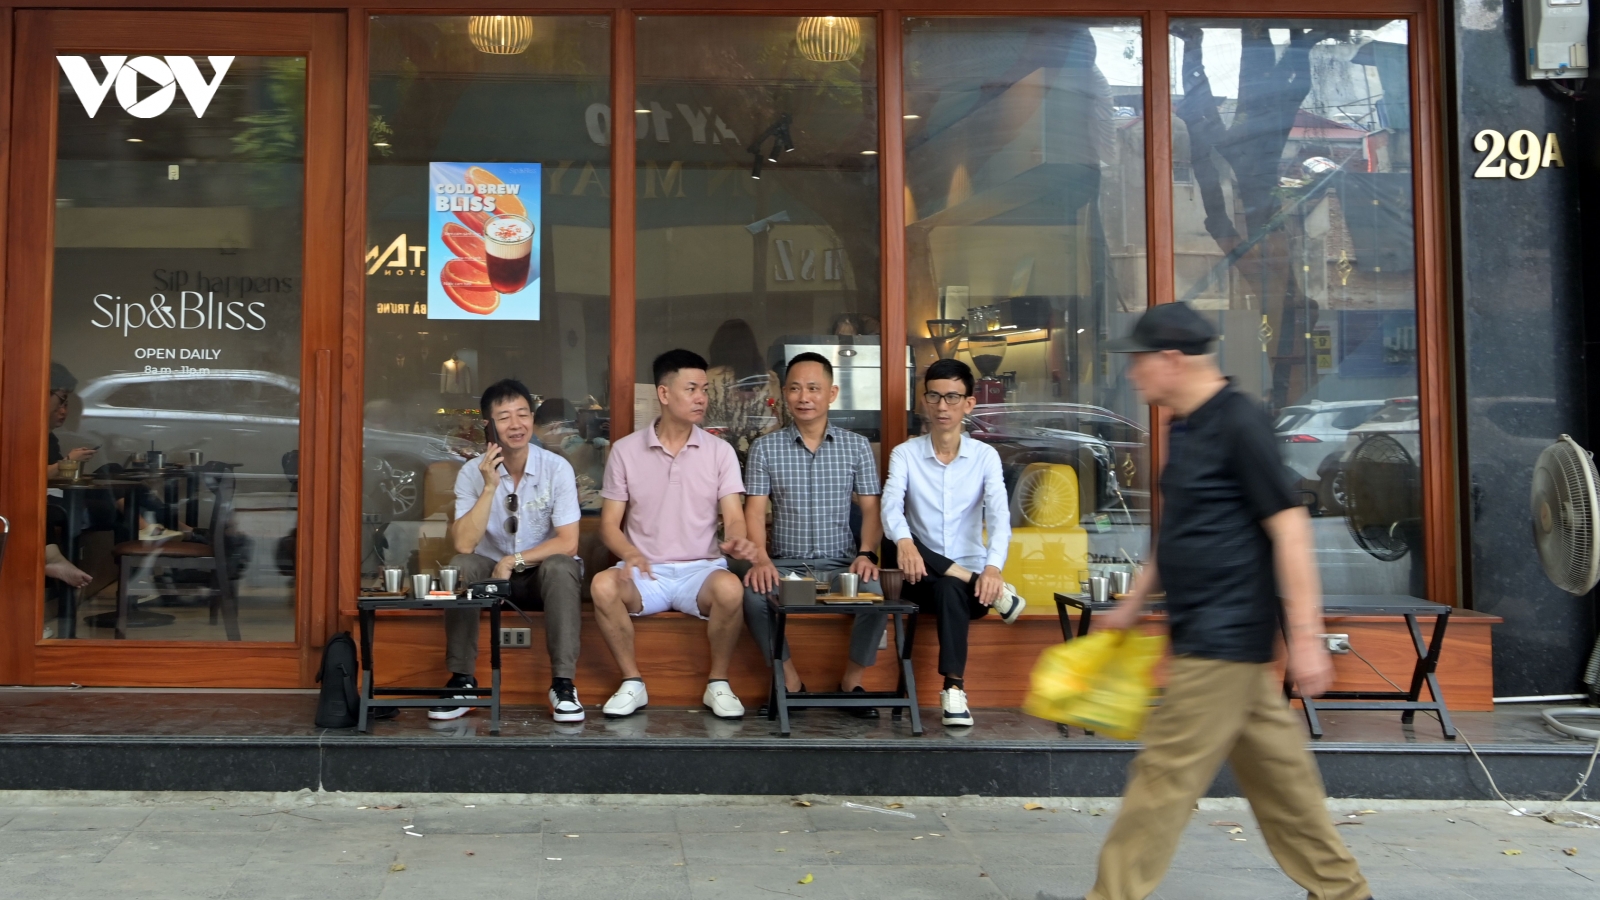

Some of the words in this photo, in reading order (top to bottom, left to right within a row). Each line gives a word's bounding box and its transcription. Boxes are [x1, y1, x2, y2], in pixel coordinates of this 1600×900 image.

[1474, 129, 1565, 180] 29A
[436, 183, 475, 194] COLD
[478, 183, 519, 195] BREW
[436, 196, 496, 212] BLISS
[198, 271, 293, 298] happens
[134, 348, 176, 359] OPEN
[180, 349, 221, 360] DAILY
